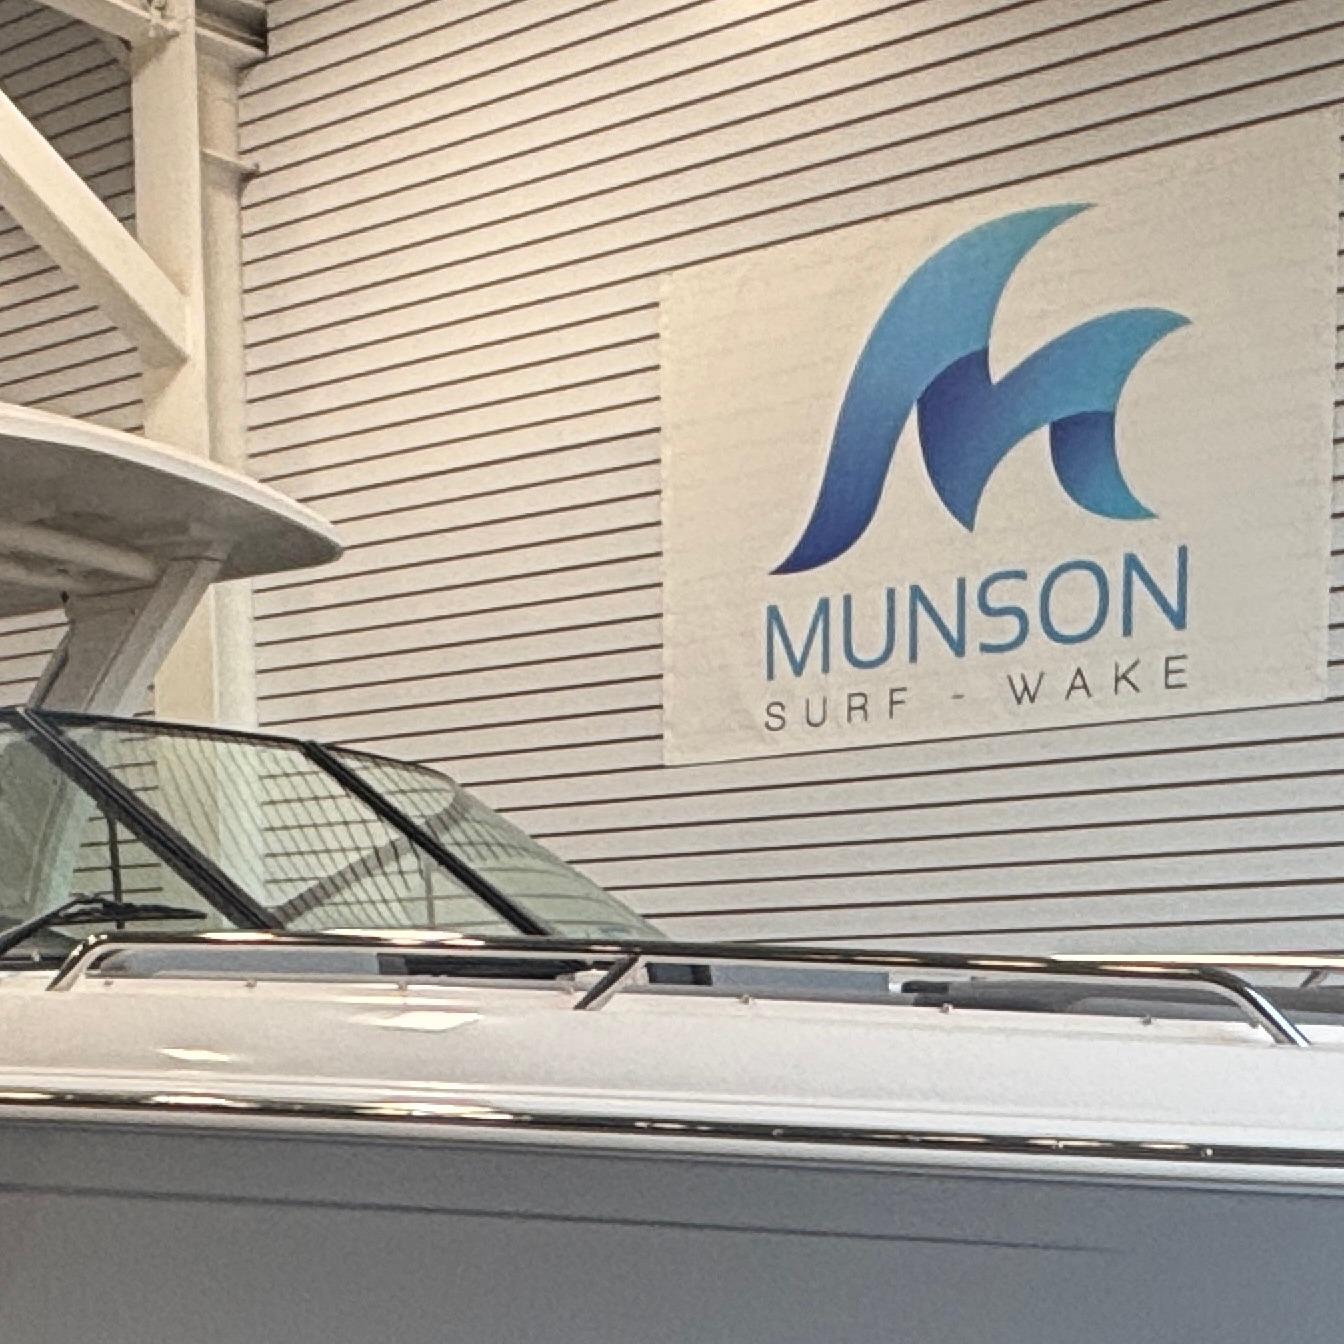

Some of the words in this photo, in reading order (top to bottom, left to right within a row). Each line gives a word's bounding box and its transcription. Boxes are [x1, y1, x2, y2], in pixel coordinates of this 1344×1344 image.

[763, 544, 1189, 682] MUNSON
[763, 686, 908, 733] SURF
[1008, 653, 1190, 706] WAKE
